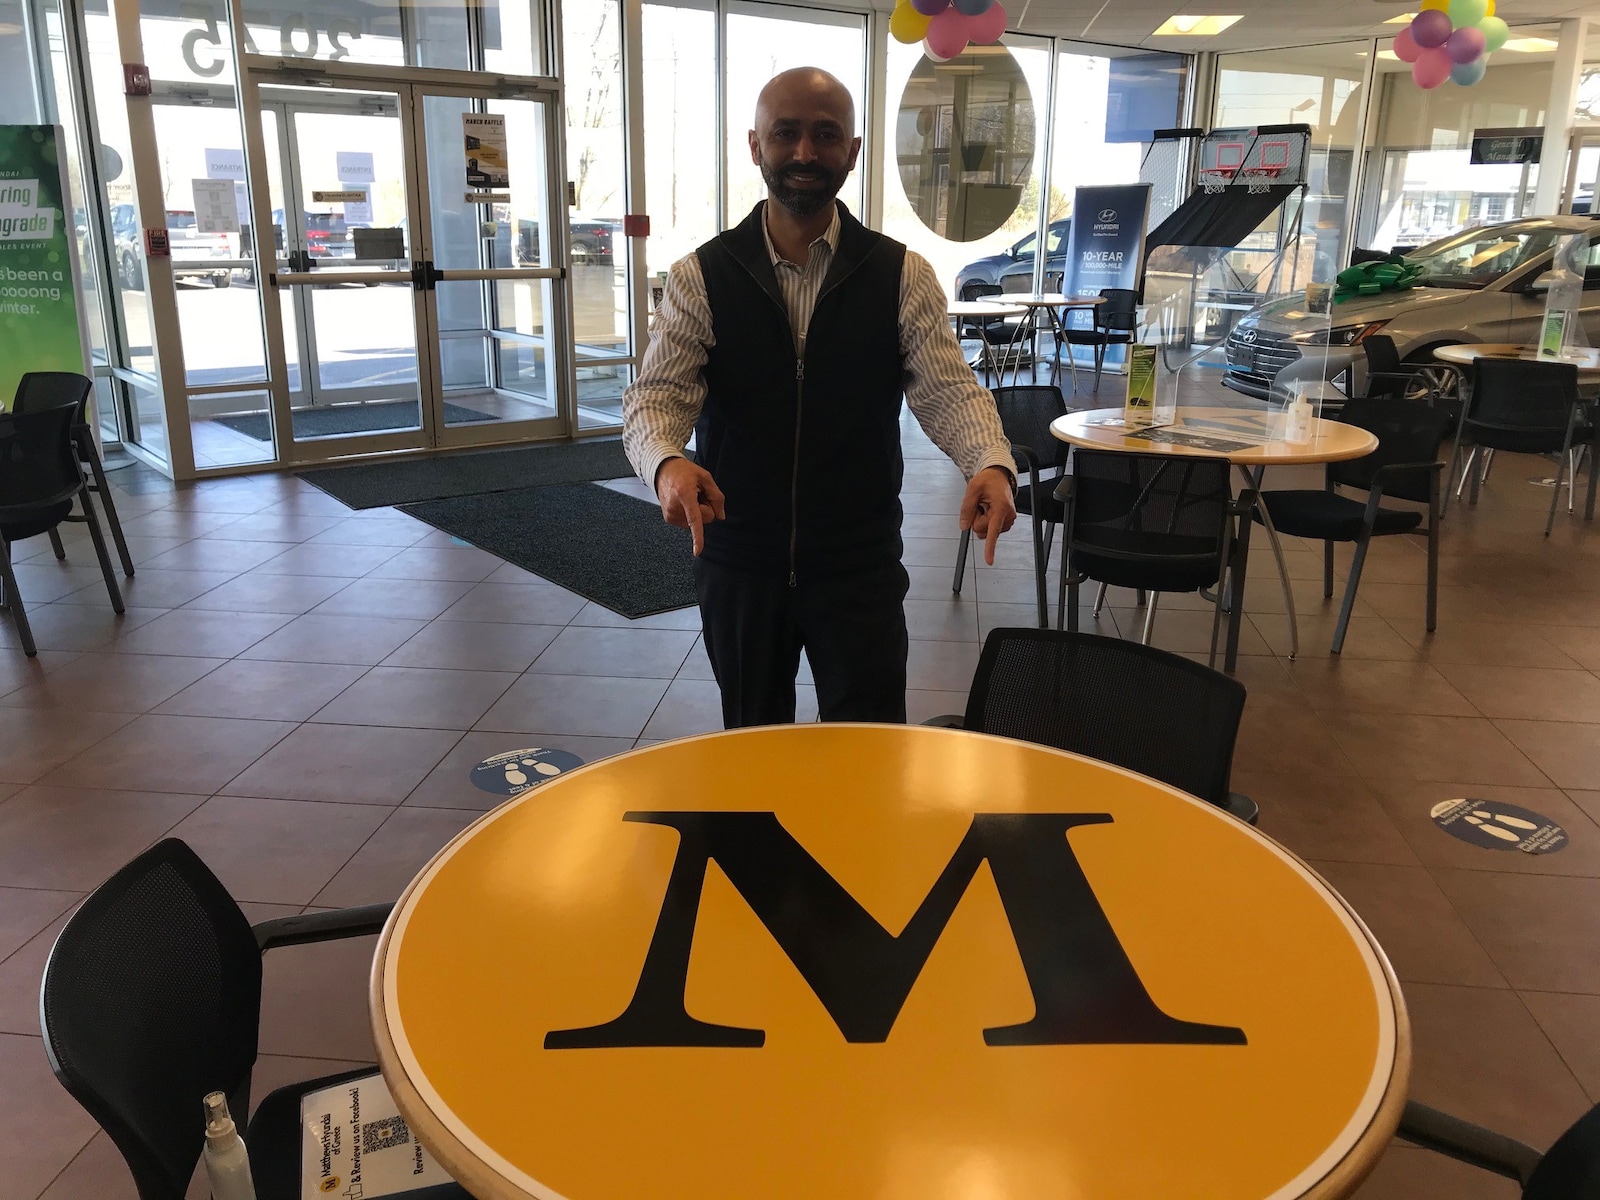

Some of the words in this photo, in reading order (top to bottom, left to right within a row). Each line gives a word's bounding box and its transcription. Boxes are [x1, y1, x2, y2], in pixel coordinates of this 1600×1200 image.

[1, 186, 30, 207] ring
[0, 213, 47, 236] grade
[1082, 251, 1123, 261] 10-YEAR
[6, 267, 48, 281] been
[52, 270, 63, 281] a
[0, 287, 60, 300] oooong
[543, 810, 1248, 1049] M
[320, 1113, 334, 1144] Hyundai
[332, 1126, 341, 1148] Greece
[353, 1123, 360, 1134] on
[353, 1135, 360, 1144] us
[320, 1142, 331, 1177] Matthews
[331, 1147, 341, 1155] of
[350, 1145, 361, 1176] Review
[412, 1145, 424, 1175] Review
[351, 1174, 361, 1183] &
